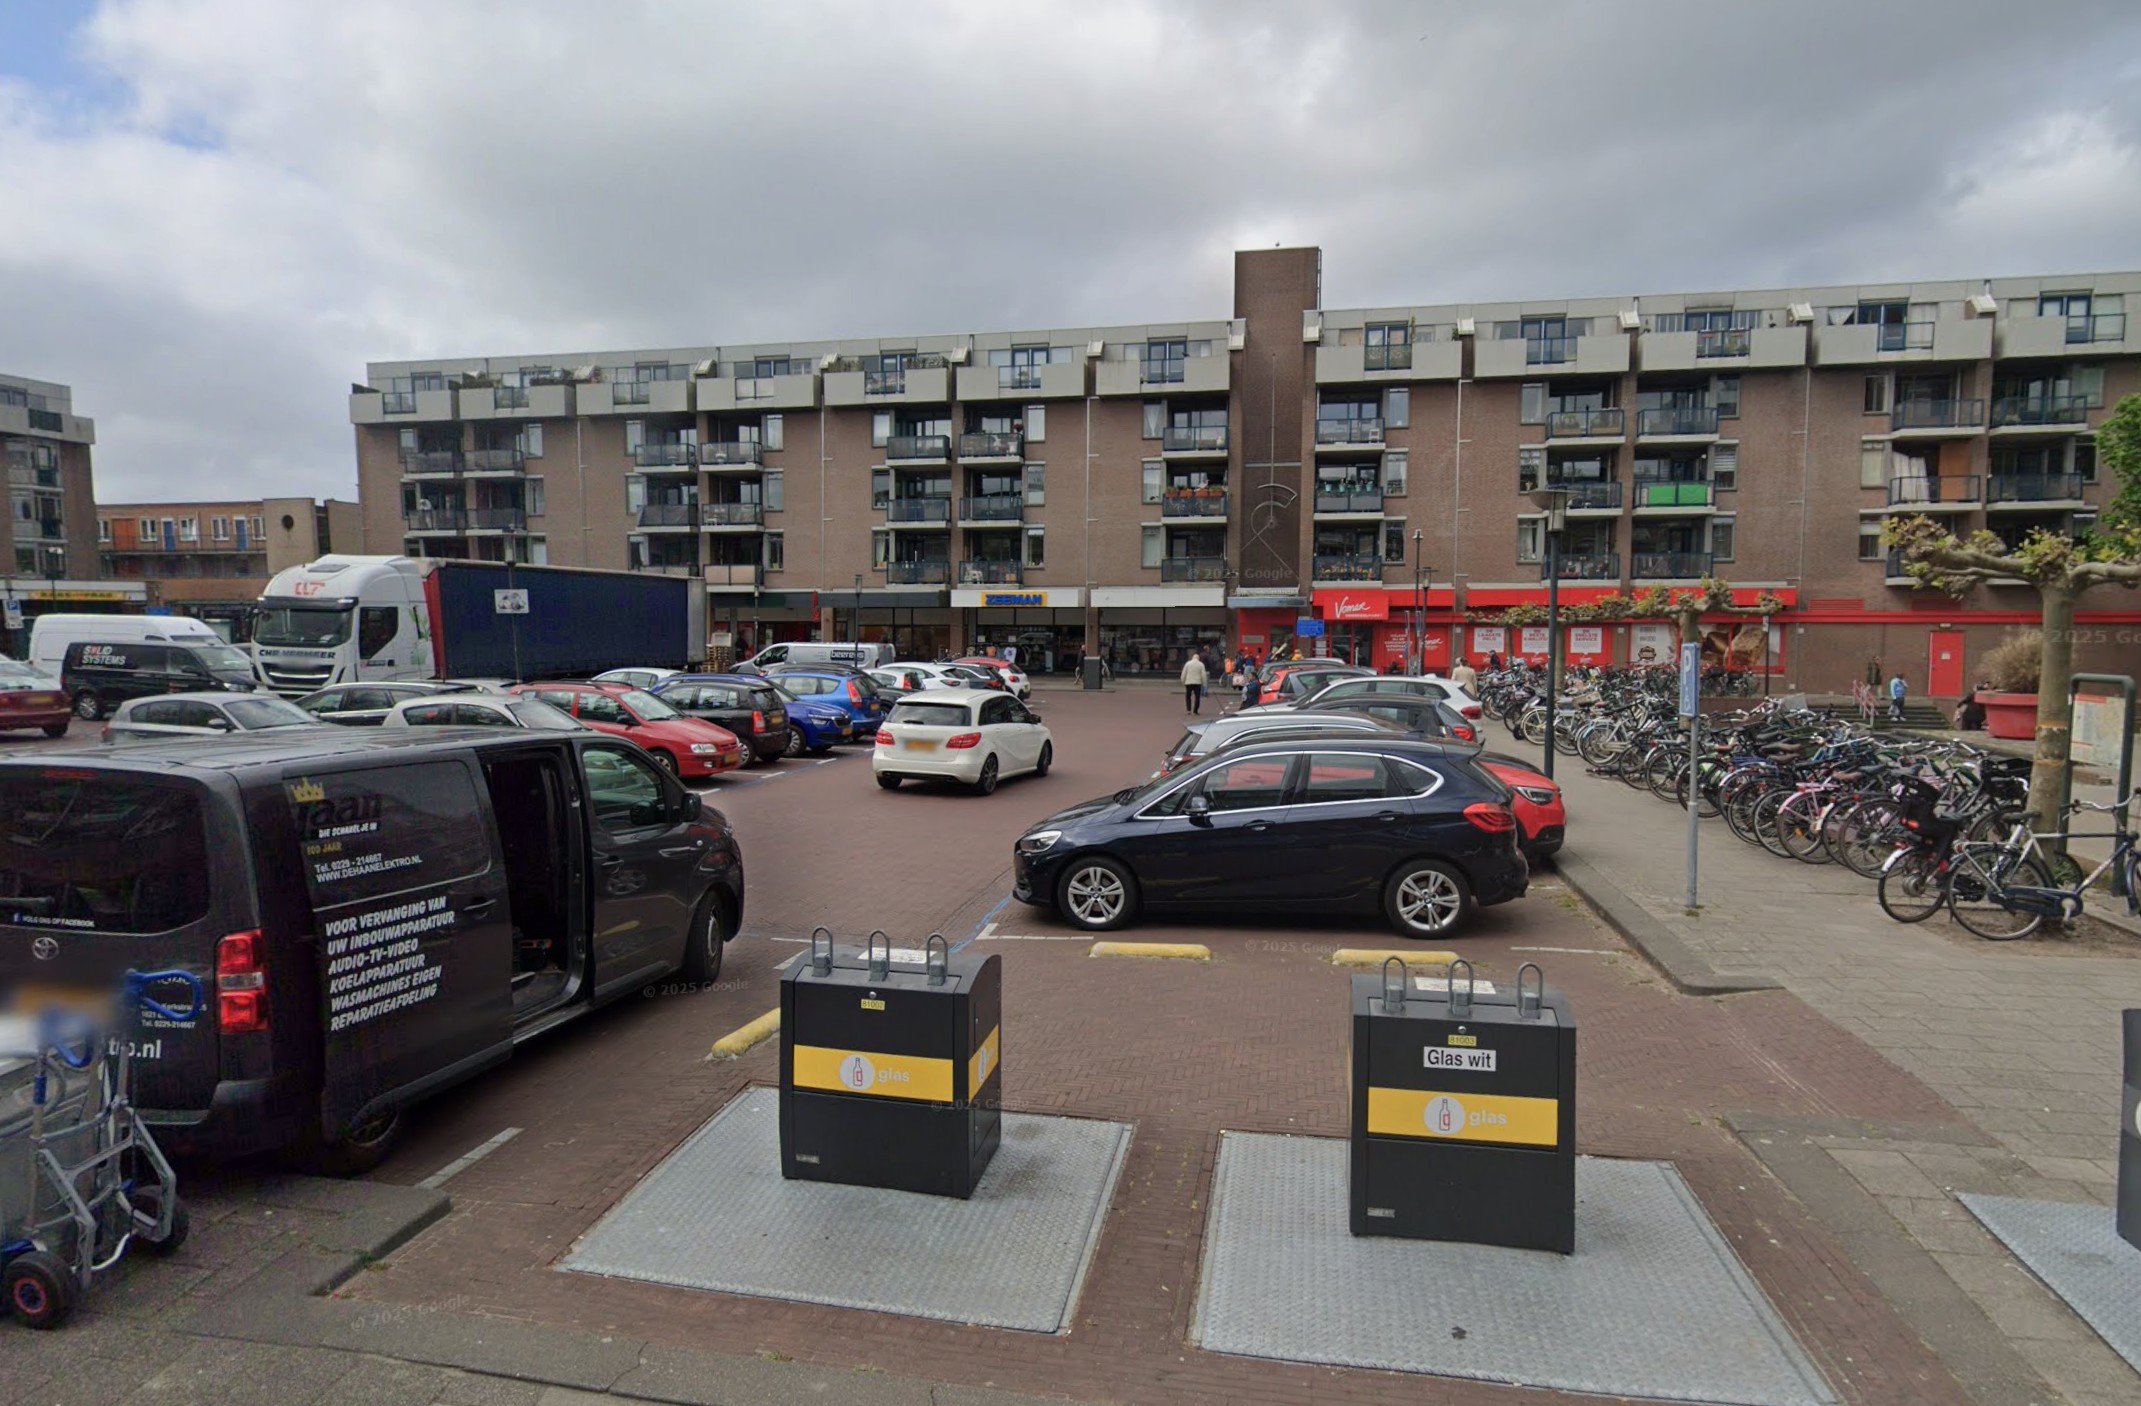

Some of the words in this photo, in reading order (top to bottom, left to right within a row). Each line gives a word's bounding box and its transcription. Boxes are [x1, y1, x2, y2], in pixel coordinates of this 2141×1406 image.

[985, 594, 1043, 605] ZEEMAN
[1335, 596, 1371, 619] Vomar
[82, 655, 126, 665] SYSTEMS
[1684, 650, 1692, 685] P
[322, 842, 342, 853] JAAR
[314, 864, 330, 874] Tel.
[331, 859, 350, 871] 0229
[315, 855, 423, 883] WWW.DEHAANELEKTRO.NL
[61, 918, 95, 928] FACEBOOK
[326, 917, 357, 937] VOOR
[359, 901, 426, 928] VERVANGING
[428, 896, 447, 911] VAN
[328, 938, 347, 955] UW
[350, 911, 455, 950] INBOUWAPPARATUUR
[328, 939, 418, 975] AUDIO-TV-VIDEO
[330, 954, 425, 994] KOELAPPARATUUR
[331, 975, 411, 1012] WASMACHINES
[413, 965, 442, 986] EIGEN
[331, 983, 437, 1031] REPARATIEAFDELING
[1450, 1036, 1475, 1045] 81003
[1427, 1049, 1463, 1067] Glas
[1468, 1052, 1492, 1068] wit
[878, 1068, 910, 1083] glas
[1469, 1109, 1508, 1127] glas
